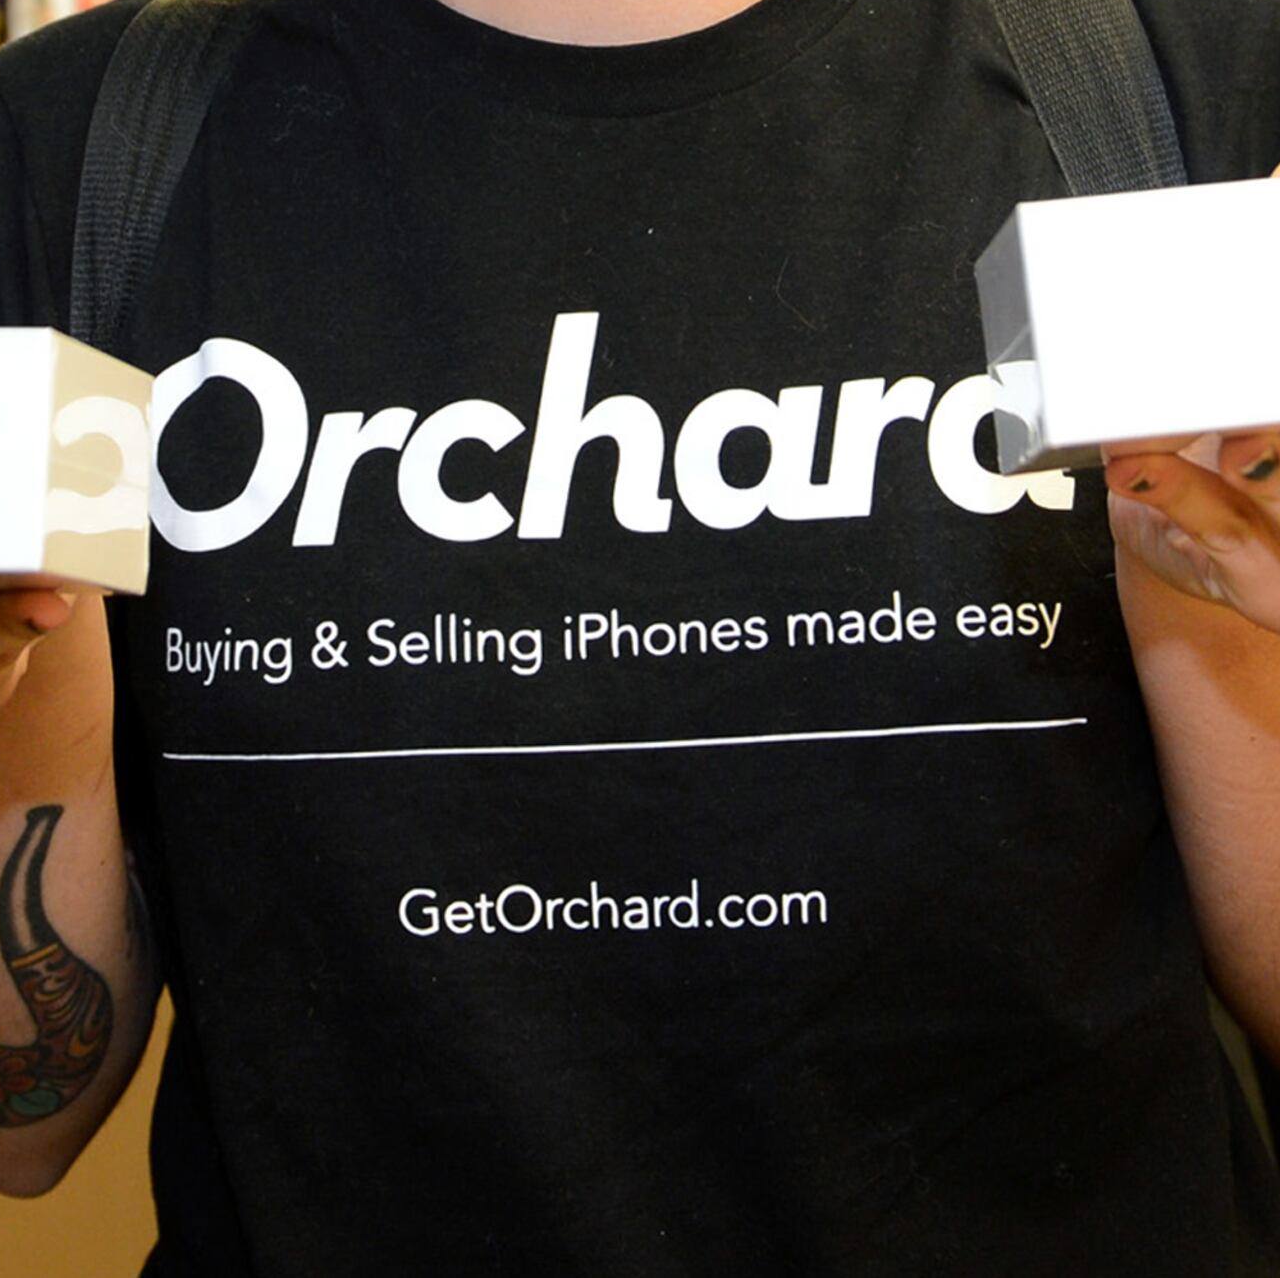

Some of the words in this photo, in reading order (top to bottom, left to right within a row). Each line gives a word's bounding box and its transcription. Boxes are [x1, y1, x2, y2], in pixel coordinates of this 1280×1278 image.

[166, 620, 293, 686] Buying
[311, 620, 349, 670] &
[367, 612, 543, 676] Selling
[563, 608, 769, 661] iPhones
[786, 590, 937, 647] made
[955, 602, 1062, 649] easy
[398, 878, 827, 937] GetOrchard.com
